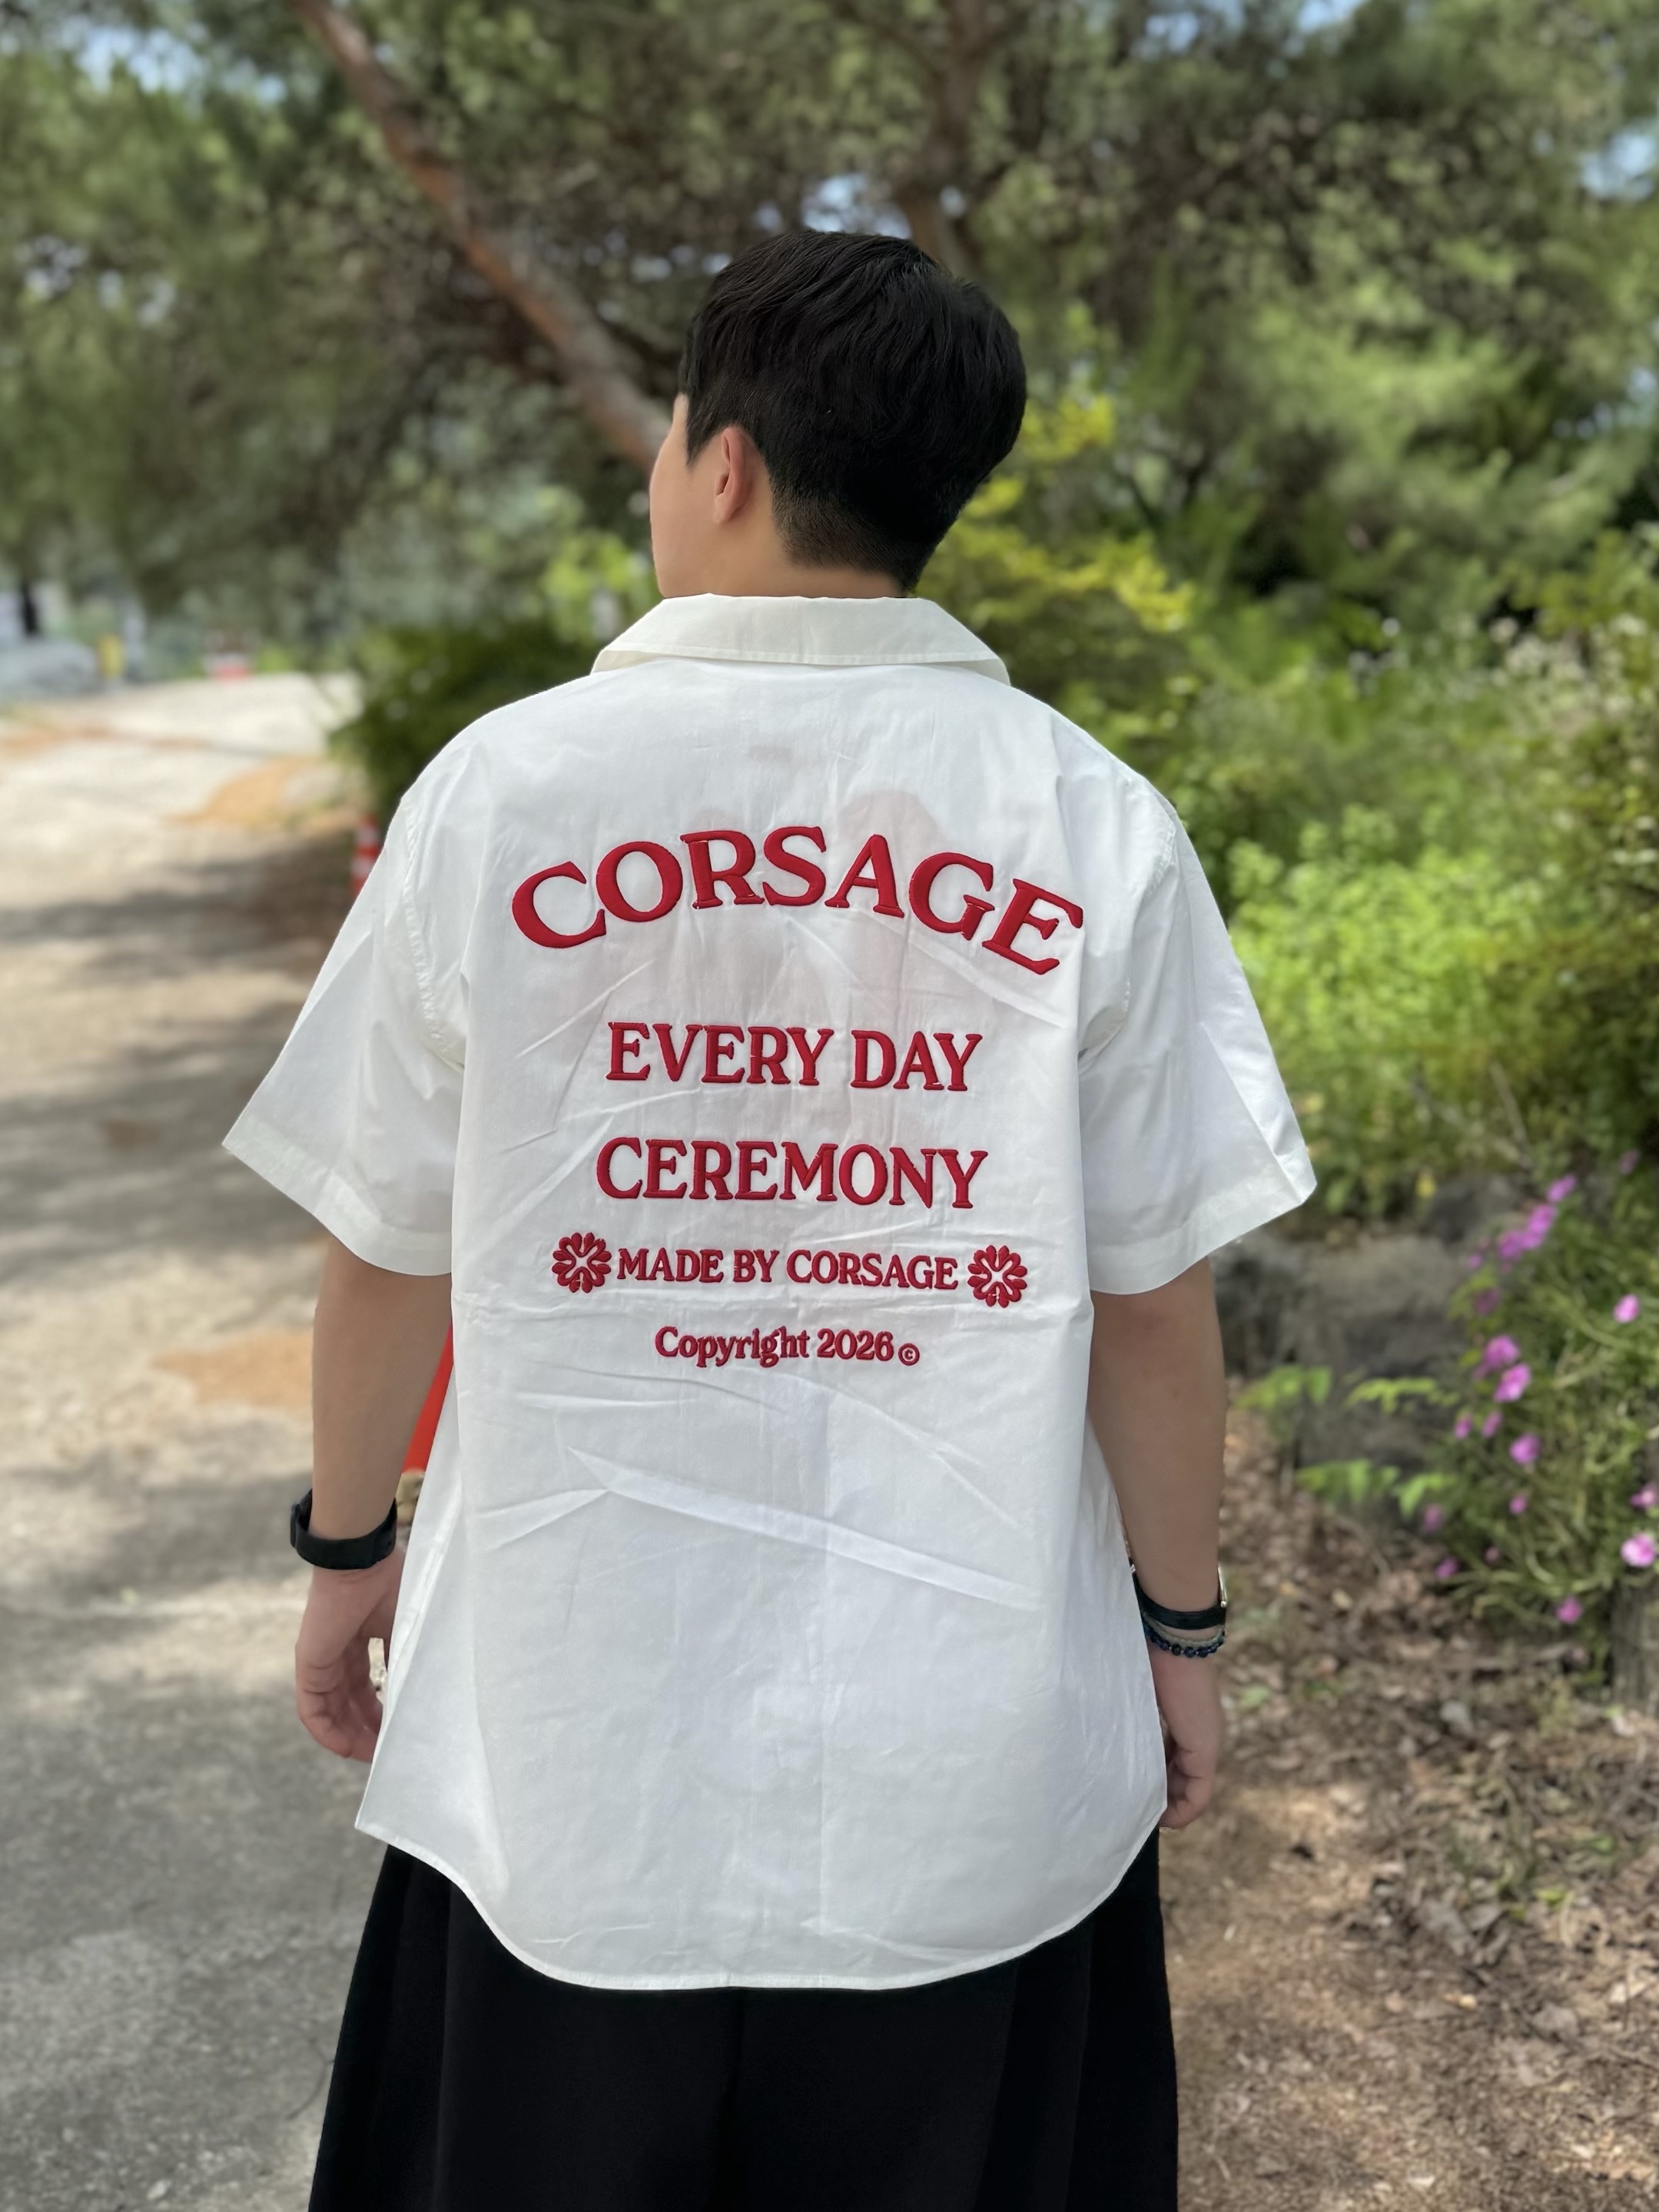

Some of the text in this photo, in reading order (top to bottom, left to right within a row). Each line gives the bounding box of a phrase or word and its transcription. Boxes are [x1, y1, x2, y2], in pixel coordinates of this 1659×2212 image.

[510, 825, 1083, 975] CORSAGE
[606, 1021, 982, 1092] EVERY DAY
[596, 1136, 987, 1209] CEREMONY
[618, 1247, 958, 1290] MADE BY CORSAGE
[654, 1326, 808, 1368] Copyright
